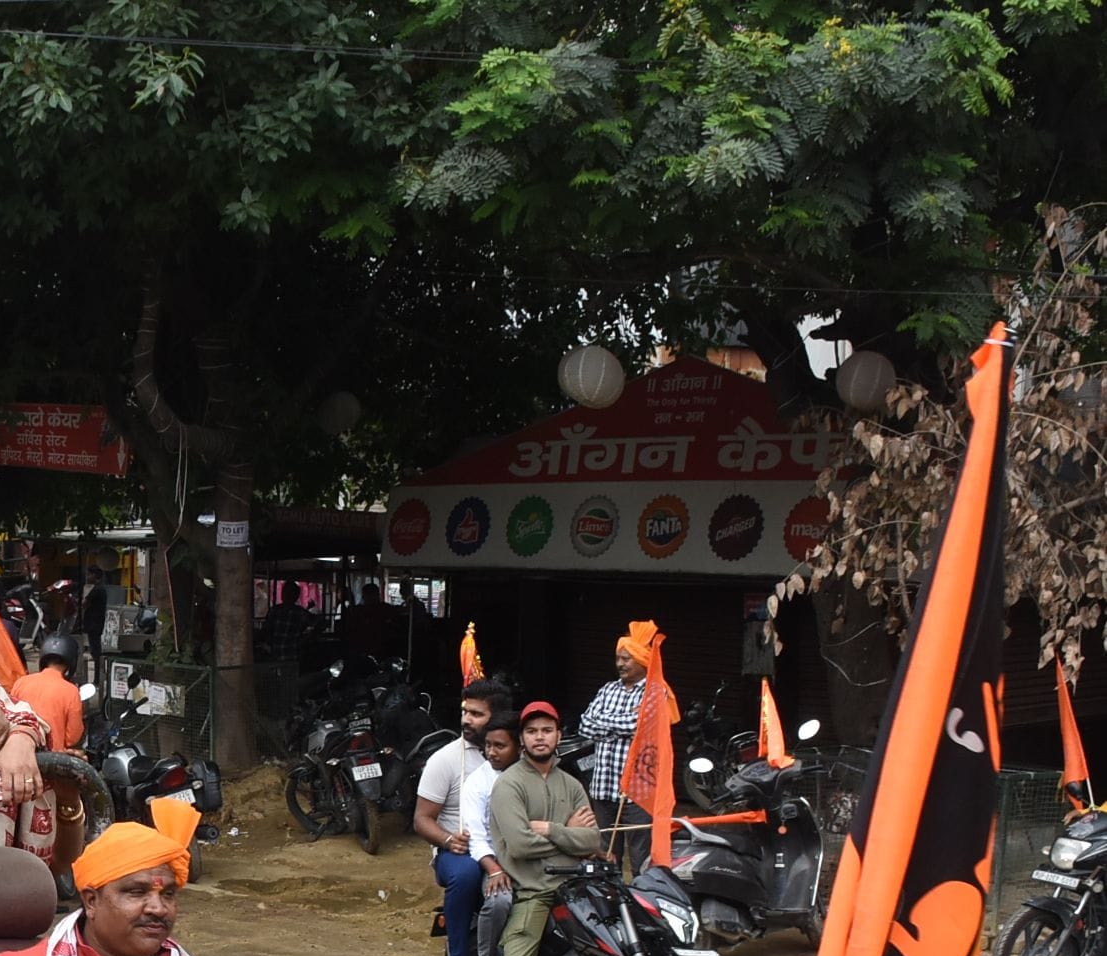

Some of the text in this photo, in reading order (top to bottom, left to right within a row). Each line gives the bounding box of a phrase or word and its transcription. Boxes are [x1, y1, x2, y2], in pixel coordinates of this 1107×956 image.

[47, 407, 81, 429] केयर
[222, 526, 245, 534] TO LET
[715, 516, 757, 542] CHARGED
